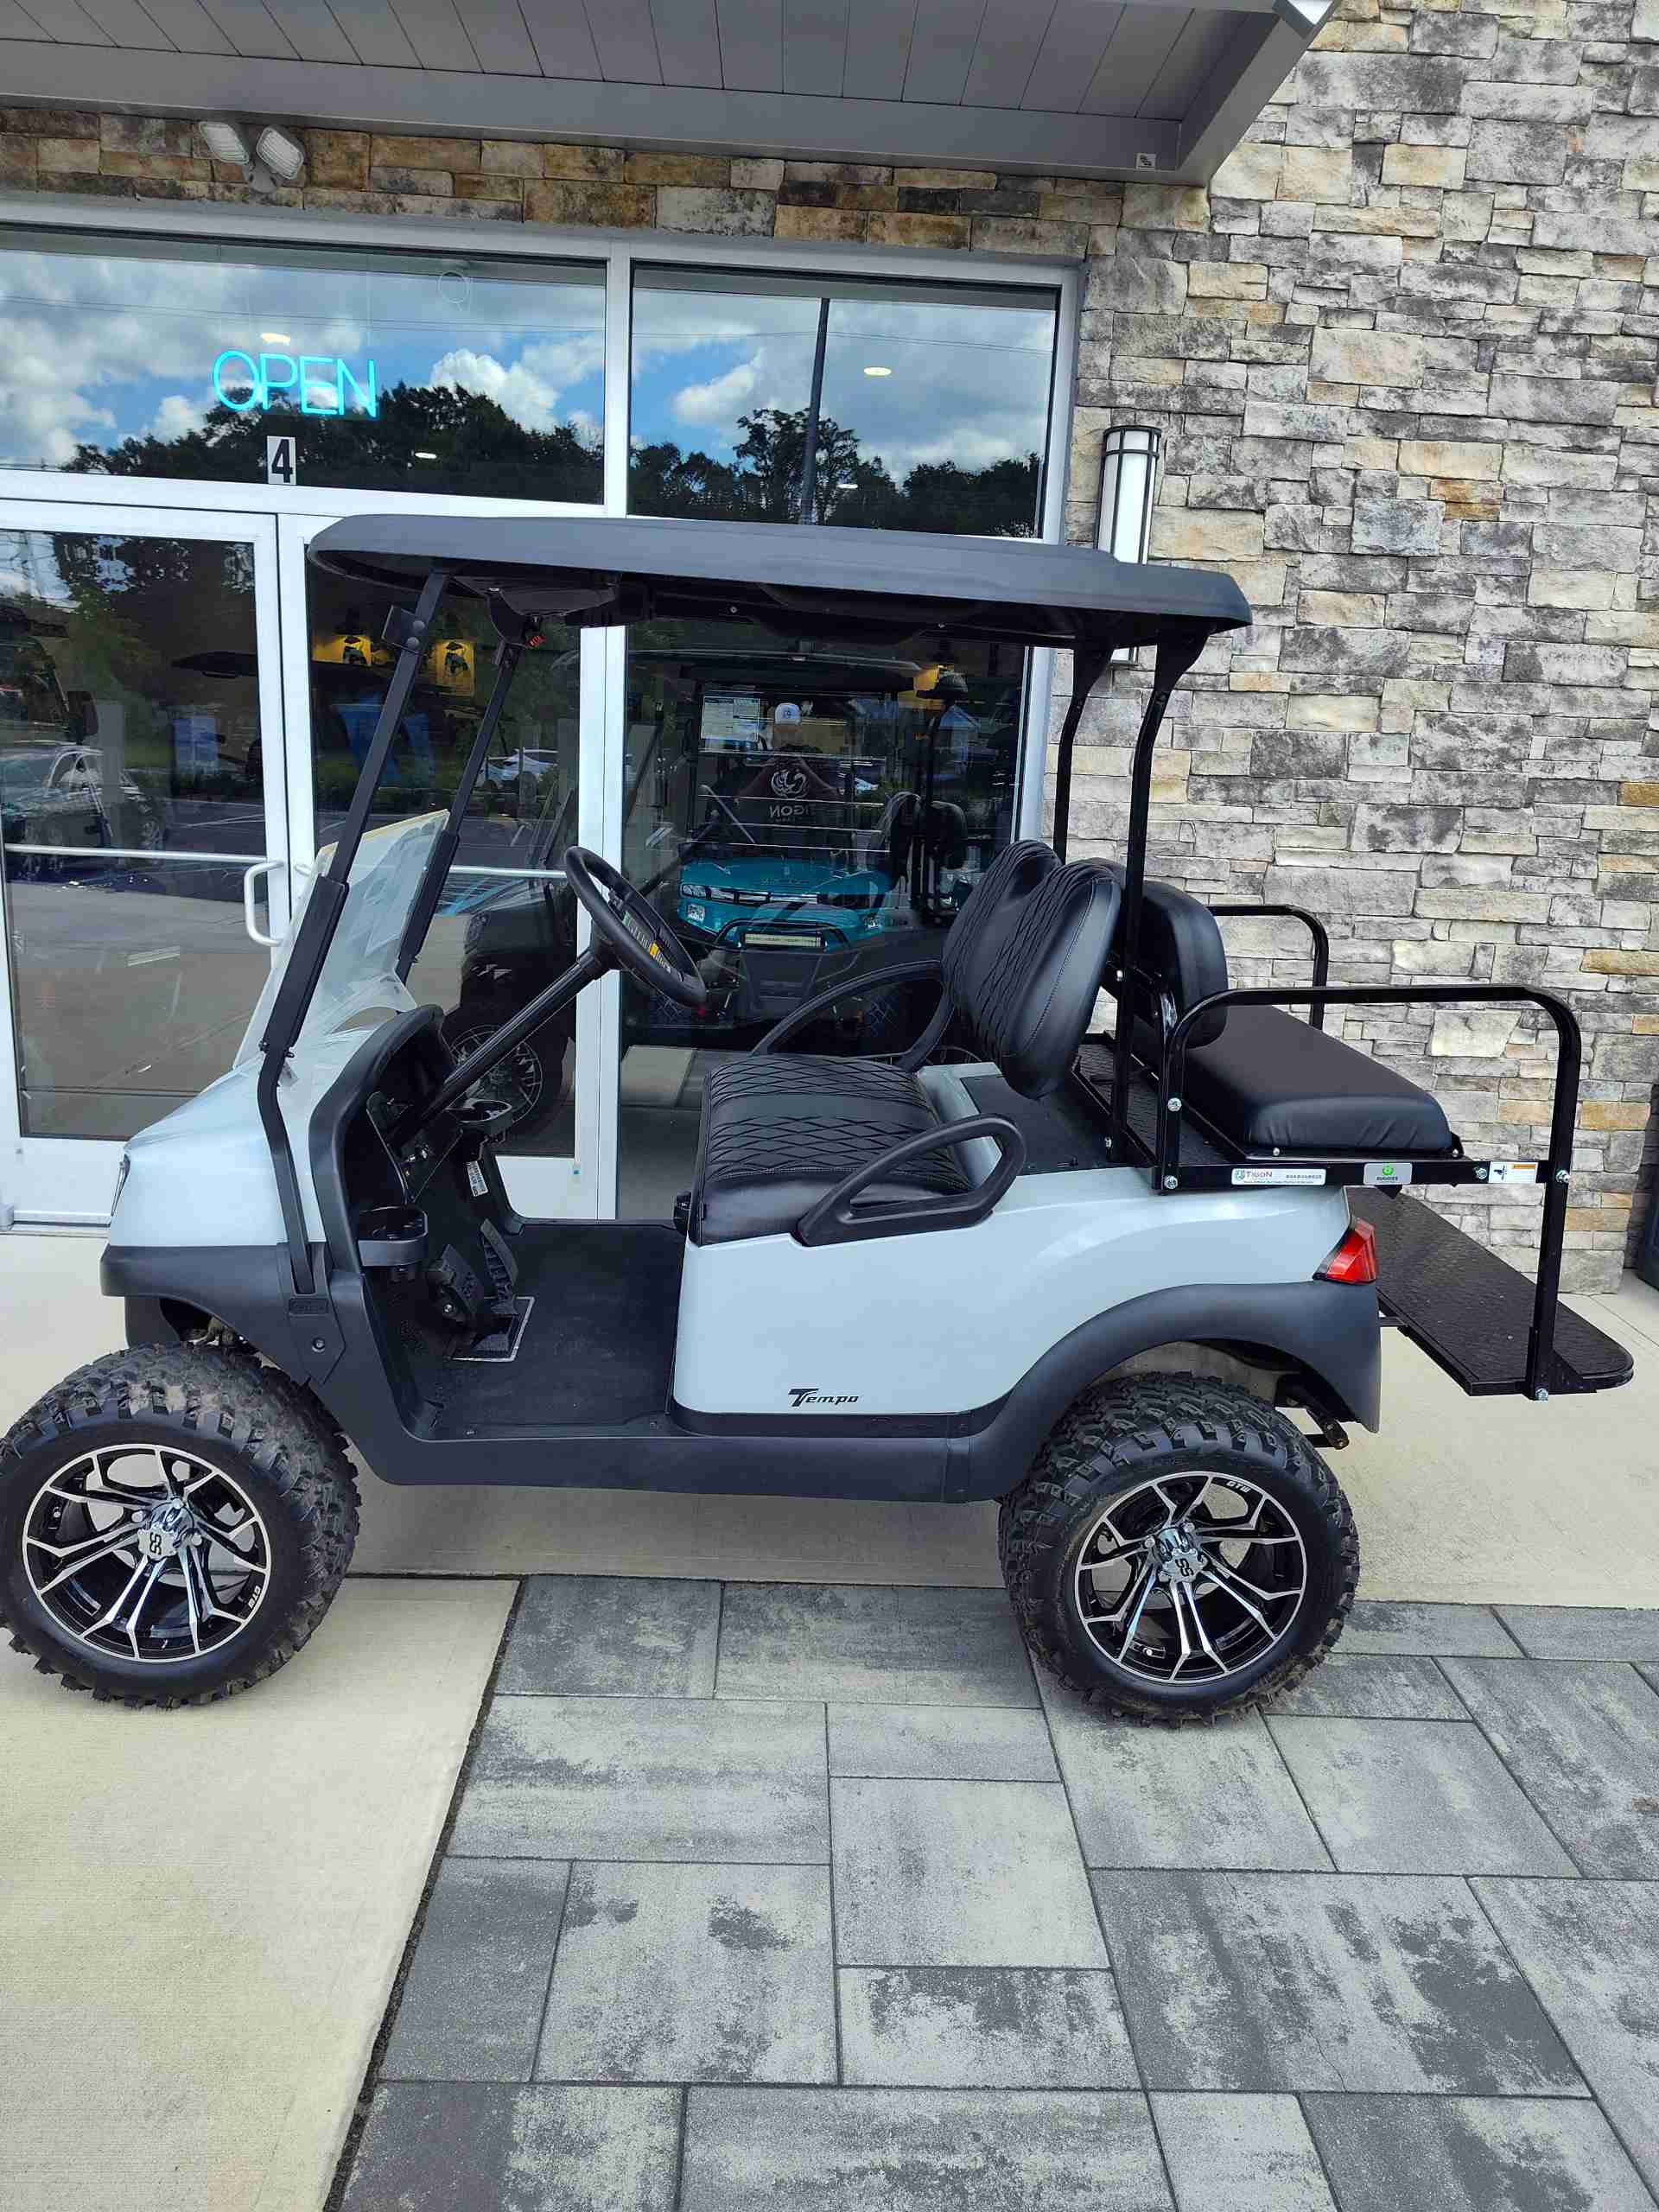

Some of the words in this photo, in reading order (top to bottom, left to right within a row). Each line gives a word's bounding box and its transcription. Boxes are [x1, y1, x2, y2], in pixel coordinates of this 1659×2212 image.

[213, 350, 377, 418] OPEN
[271, 438, 294, 484] 4
[787, 1388, 859, 1408] Tempo
